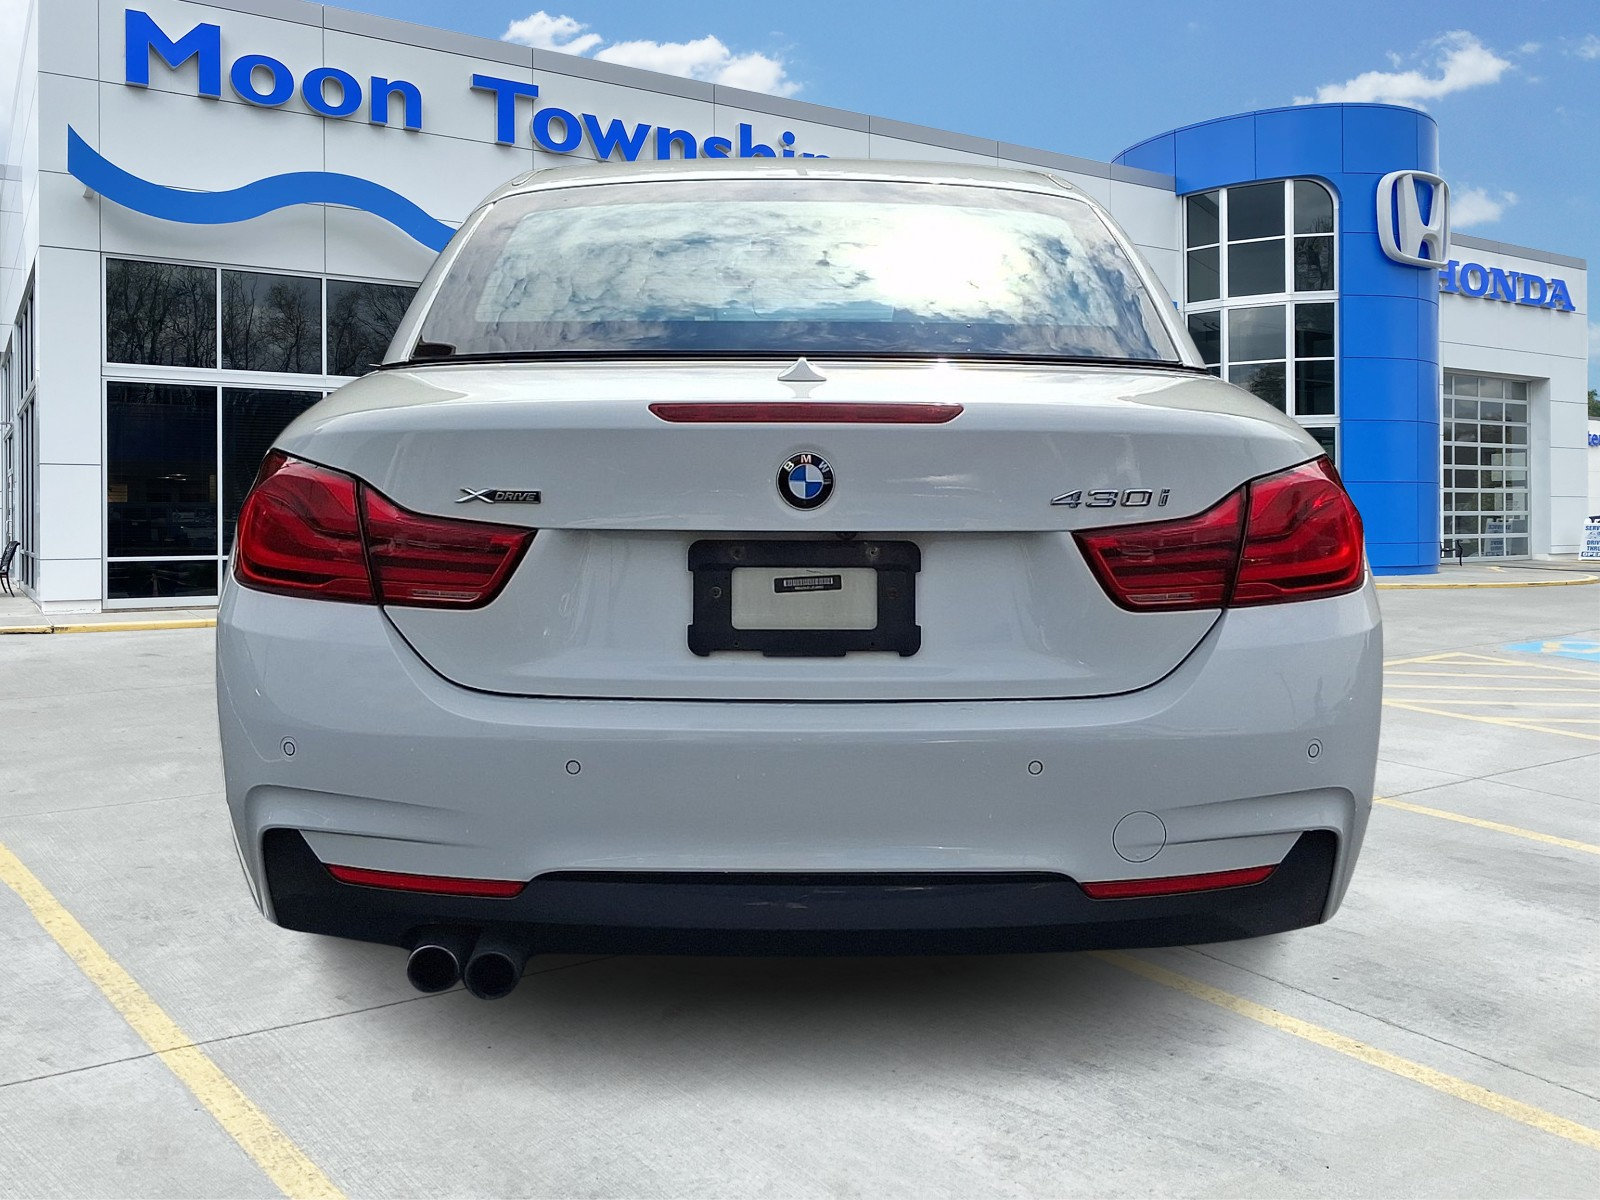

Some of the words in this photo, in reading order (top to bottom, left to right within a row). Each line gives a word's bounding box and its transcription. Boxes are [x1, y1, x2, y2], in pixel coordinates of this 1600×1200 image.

[125, 9, 422, 130] Moon
[471, 73, 830, 162] Townshi
[1439, 259, 1576, 312] HONDA
[783, 454, 830, 473] BMW
[1050, 489, 1171, 508] 430i
